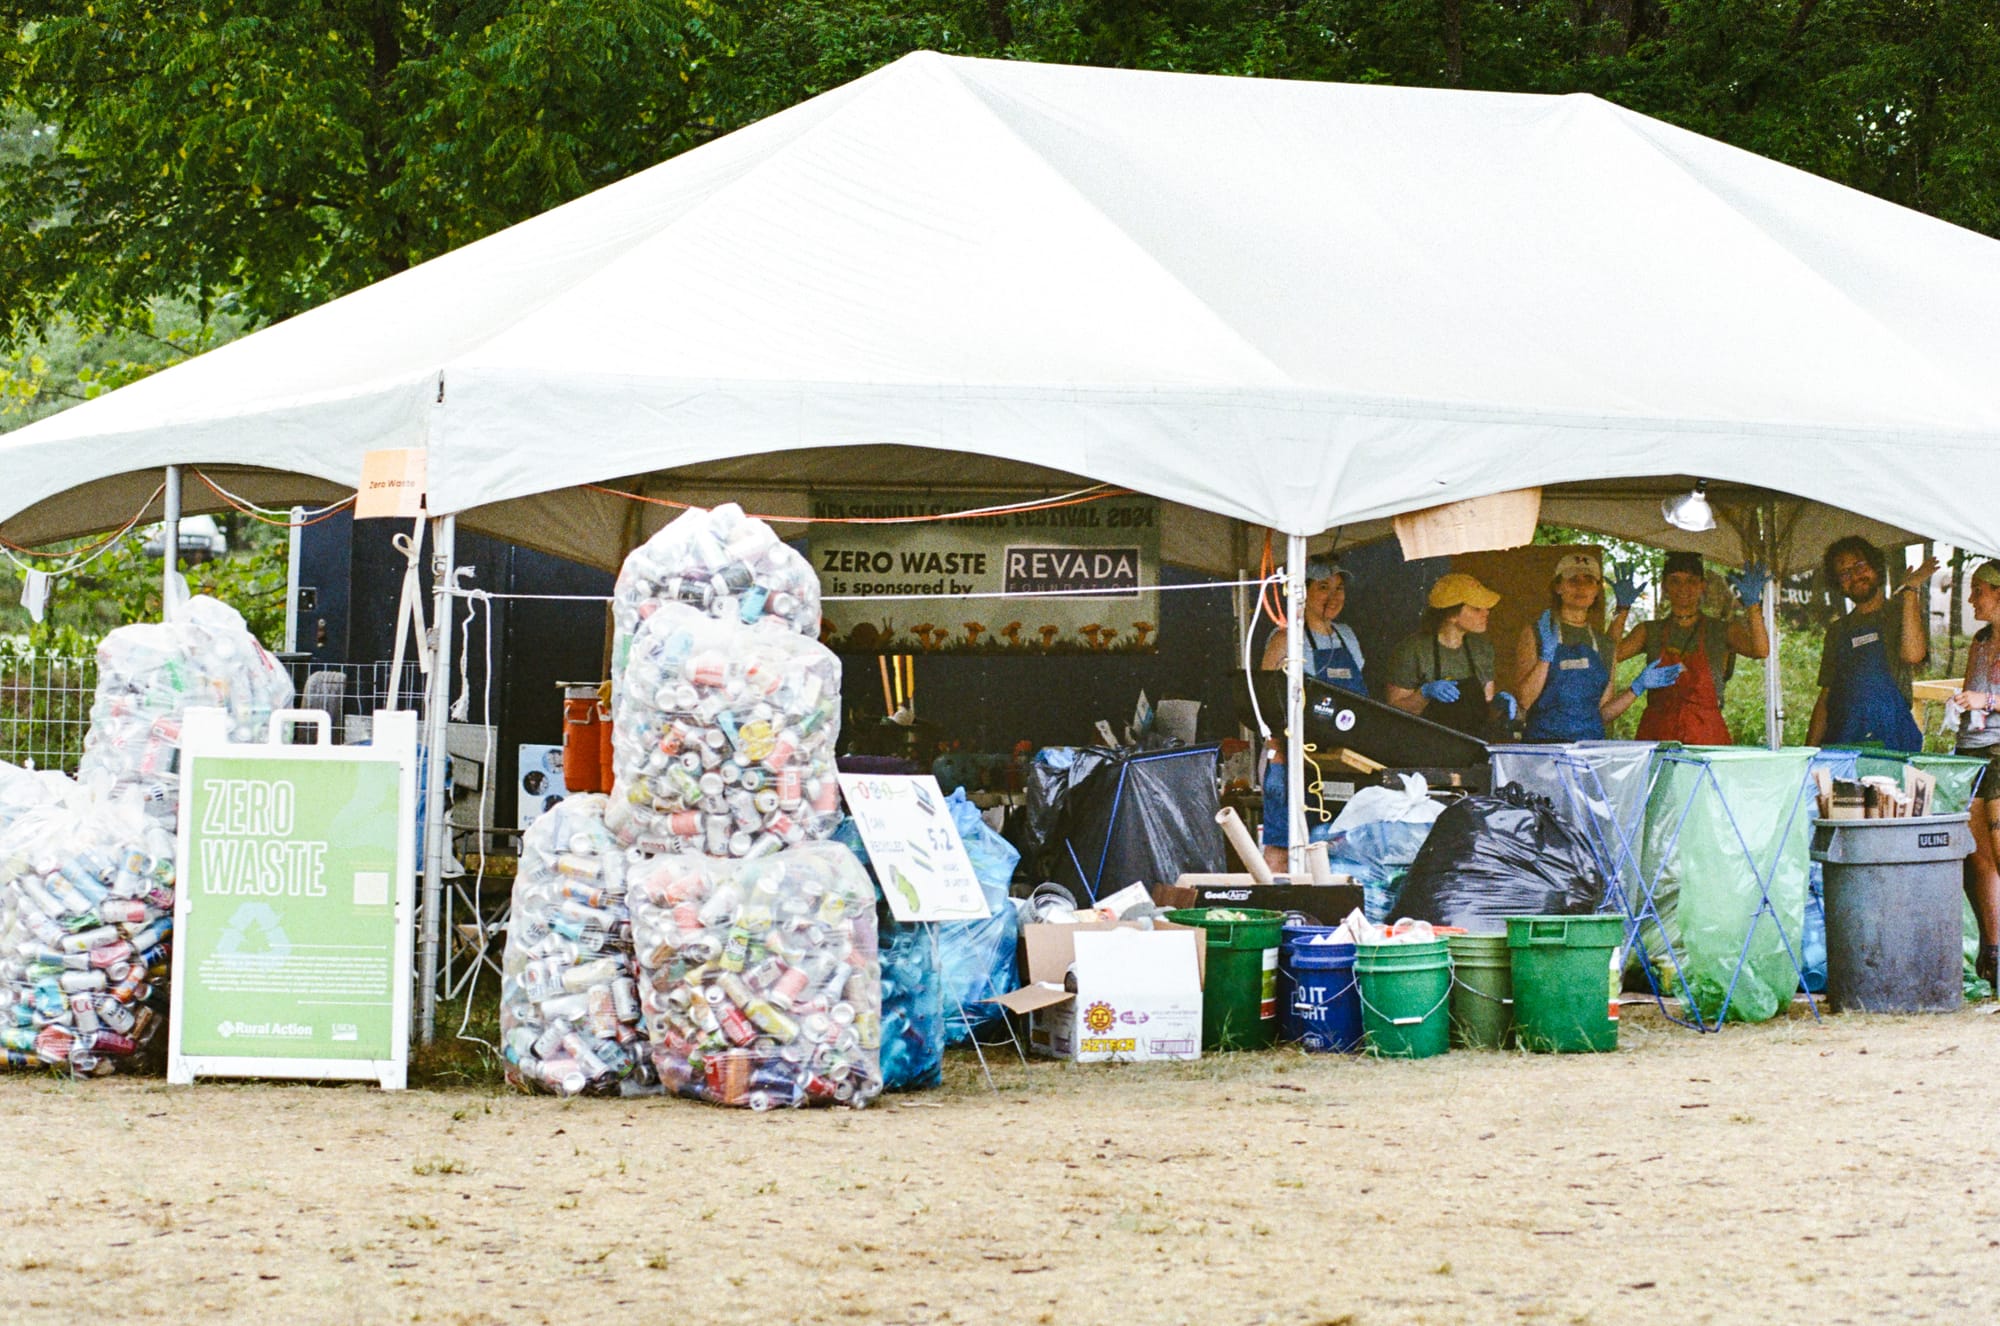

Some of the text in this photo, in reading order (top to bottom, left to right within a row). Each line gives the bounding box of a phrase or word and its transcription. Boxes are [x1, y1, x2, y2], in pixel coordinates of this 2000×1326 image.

[369, 481, 386, 489] Zero
[822, 551, 986, 574] ZERO WASTE
[1010, 553, 1134, 579] REVADA
[833, 577, 973, 598] is sponsored by
[201, 779, 294, 836] ZERO
[1920, 835, 1948, 846] ULINE
[200, 839, 327, 897] WASTE
[1309, 987, 1327, 1003] IT
[235, 1022, 270, 1034] Rural
[271, 1023, 313, 1035] Action
[1081, 1038, 1136, 1052] AZTECA
